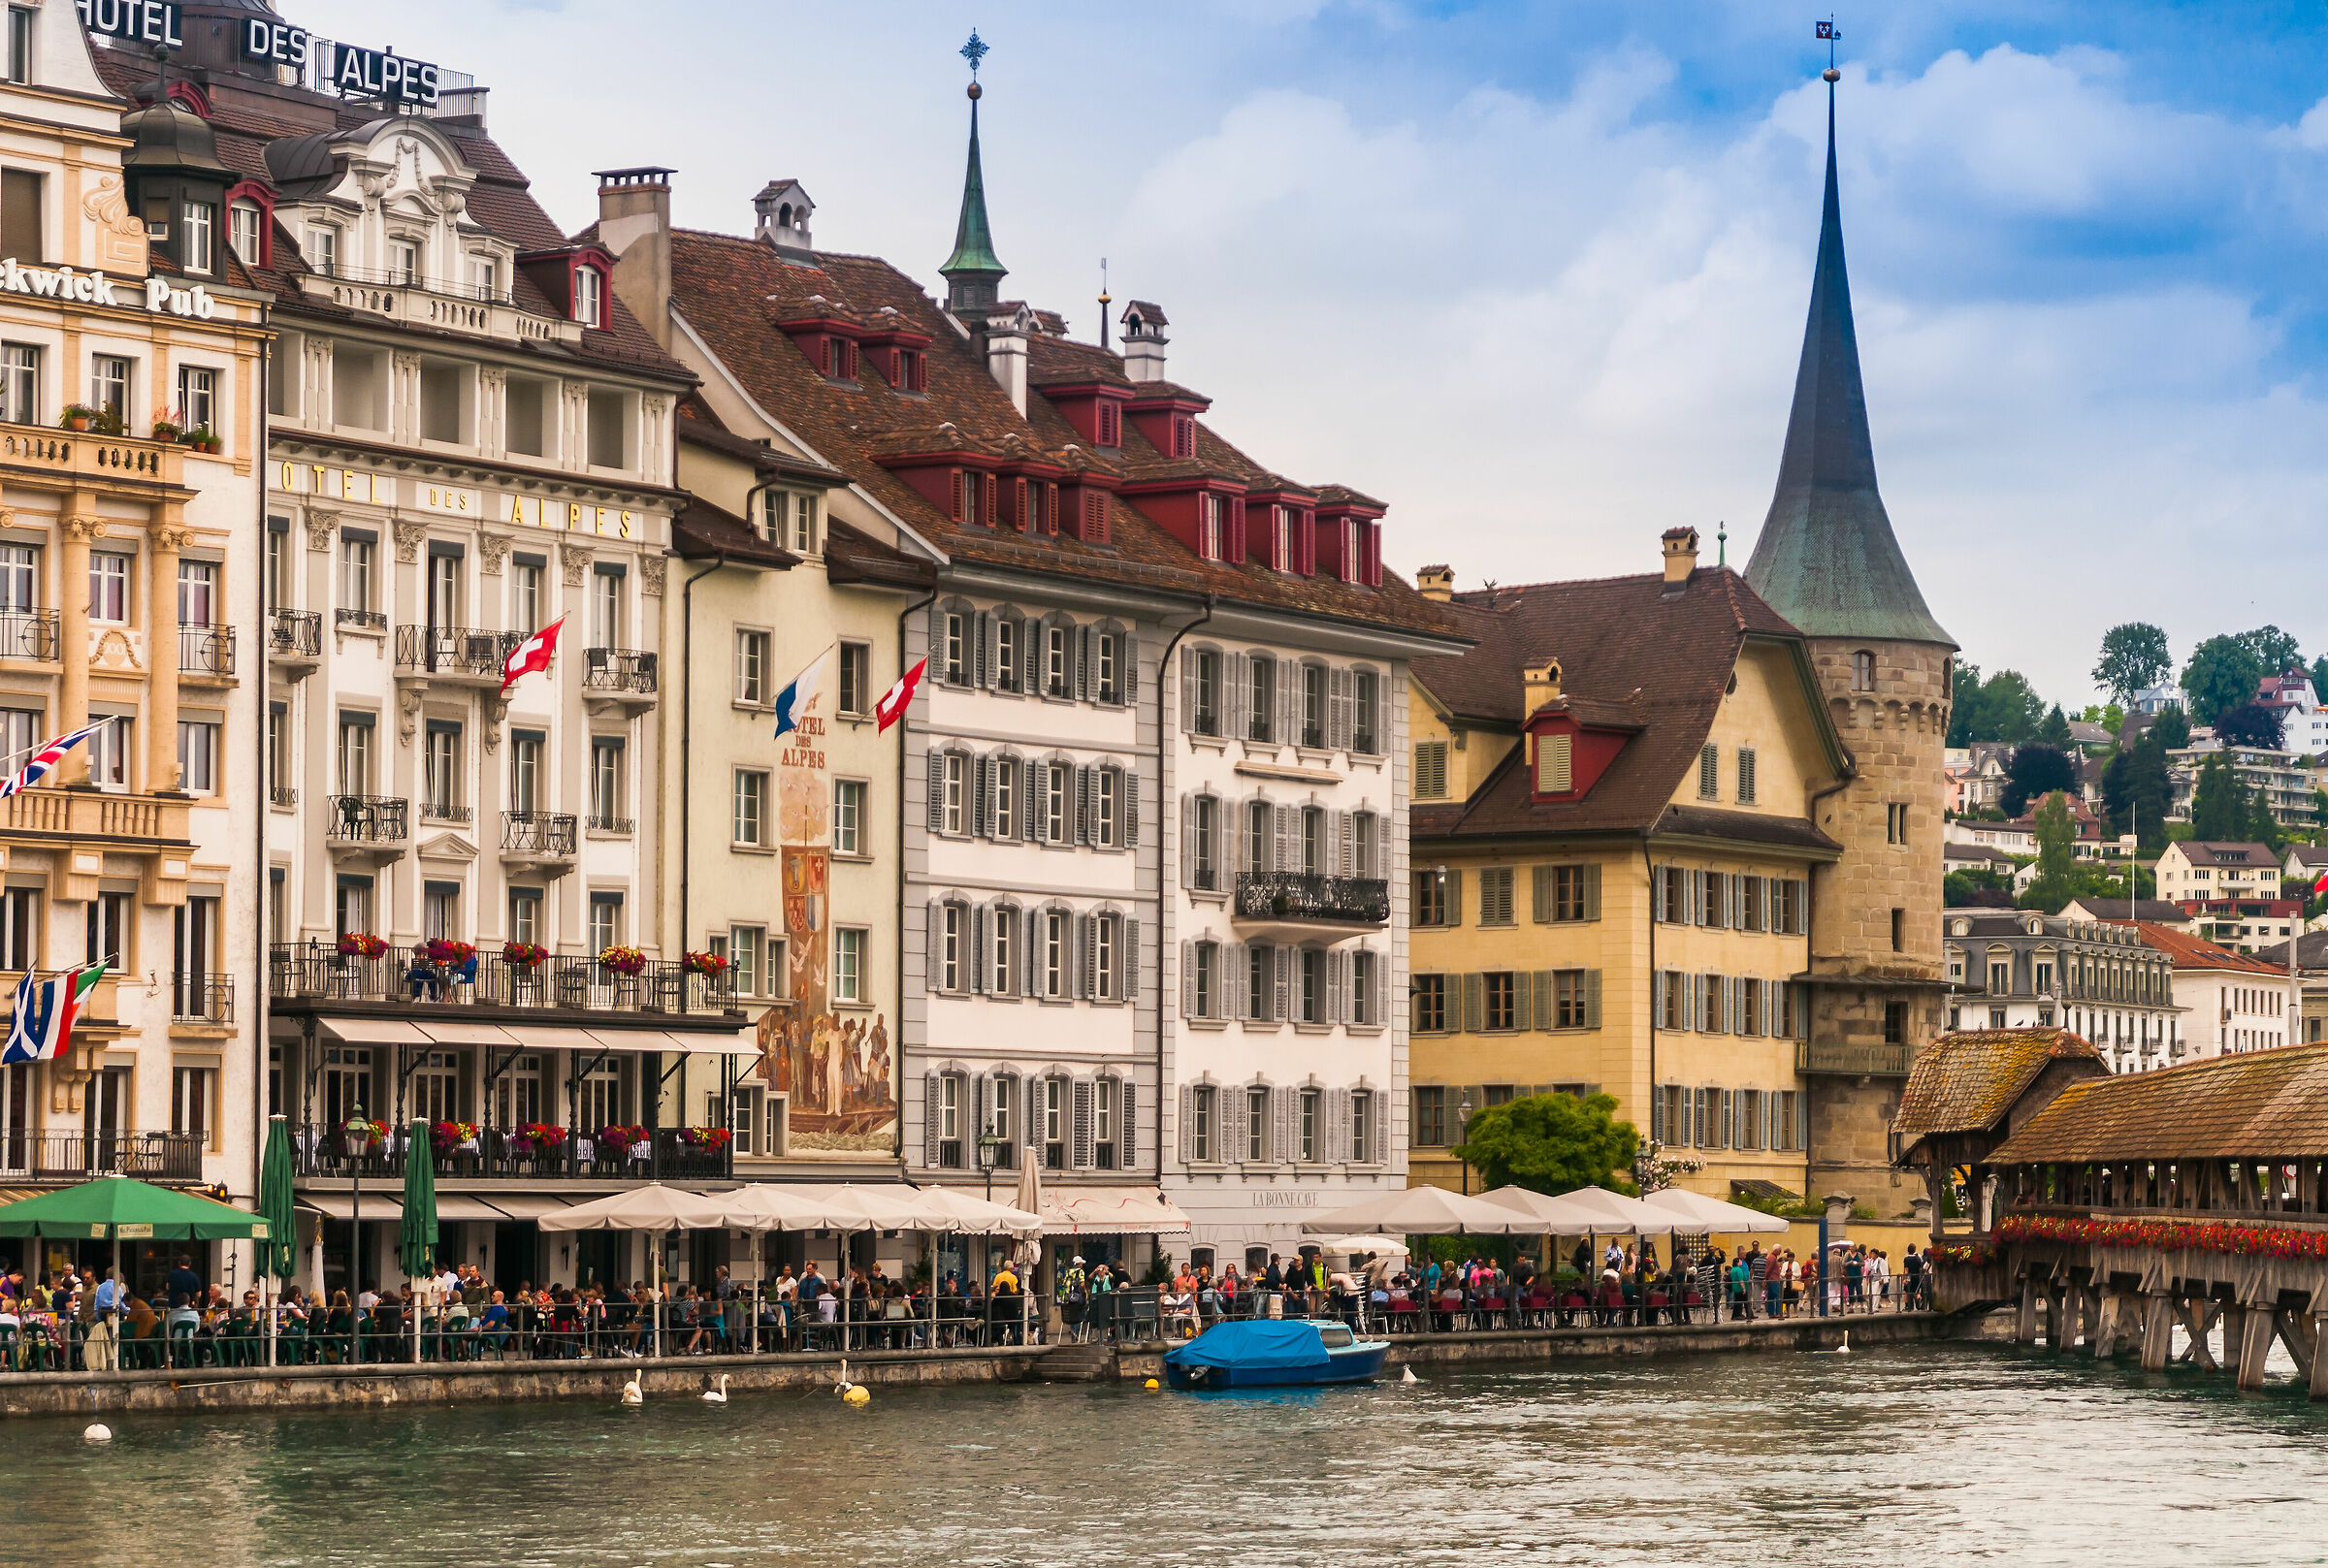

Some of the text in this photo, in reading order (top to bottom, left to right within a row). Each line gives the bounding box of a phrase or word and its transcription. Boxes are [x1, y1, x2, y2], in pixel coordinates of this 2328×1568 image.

[249, 19, 307, 64] DES
[340, 48, 439, 103] ALPES
[0, 257, 215, 319] kwick Pub
[281, 461, 631, 539] OTEL DES ALPES
[781, 748, 825, 769] ALPES
[795, 735, 812, 748] DES
[1253, 1192, 1319, 1206] LA BONNE CAVE
